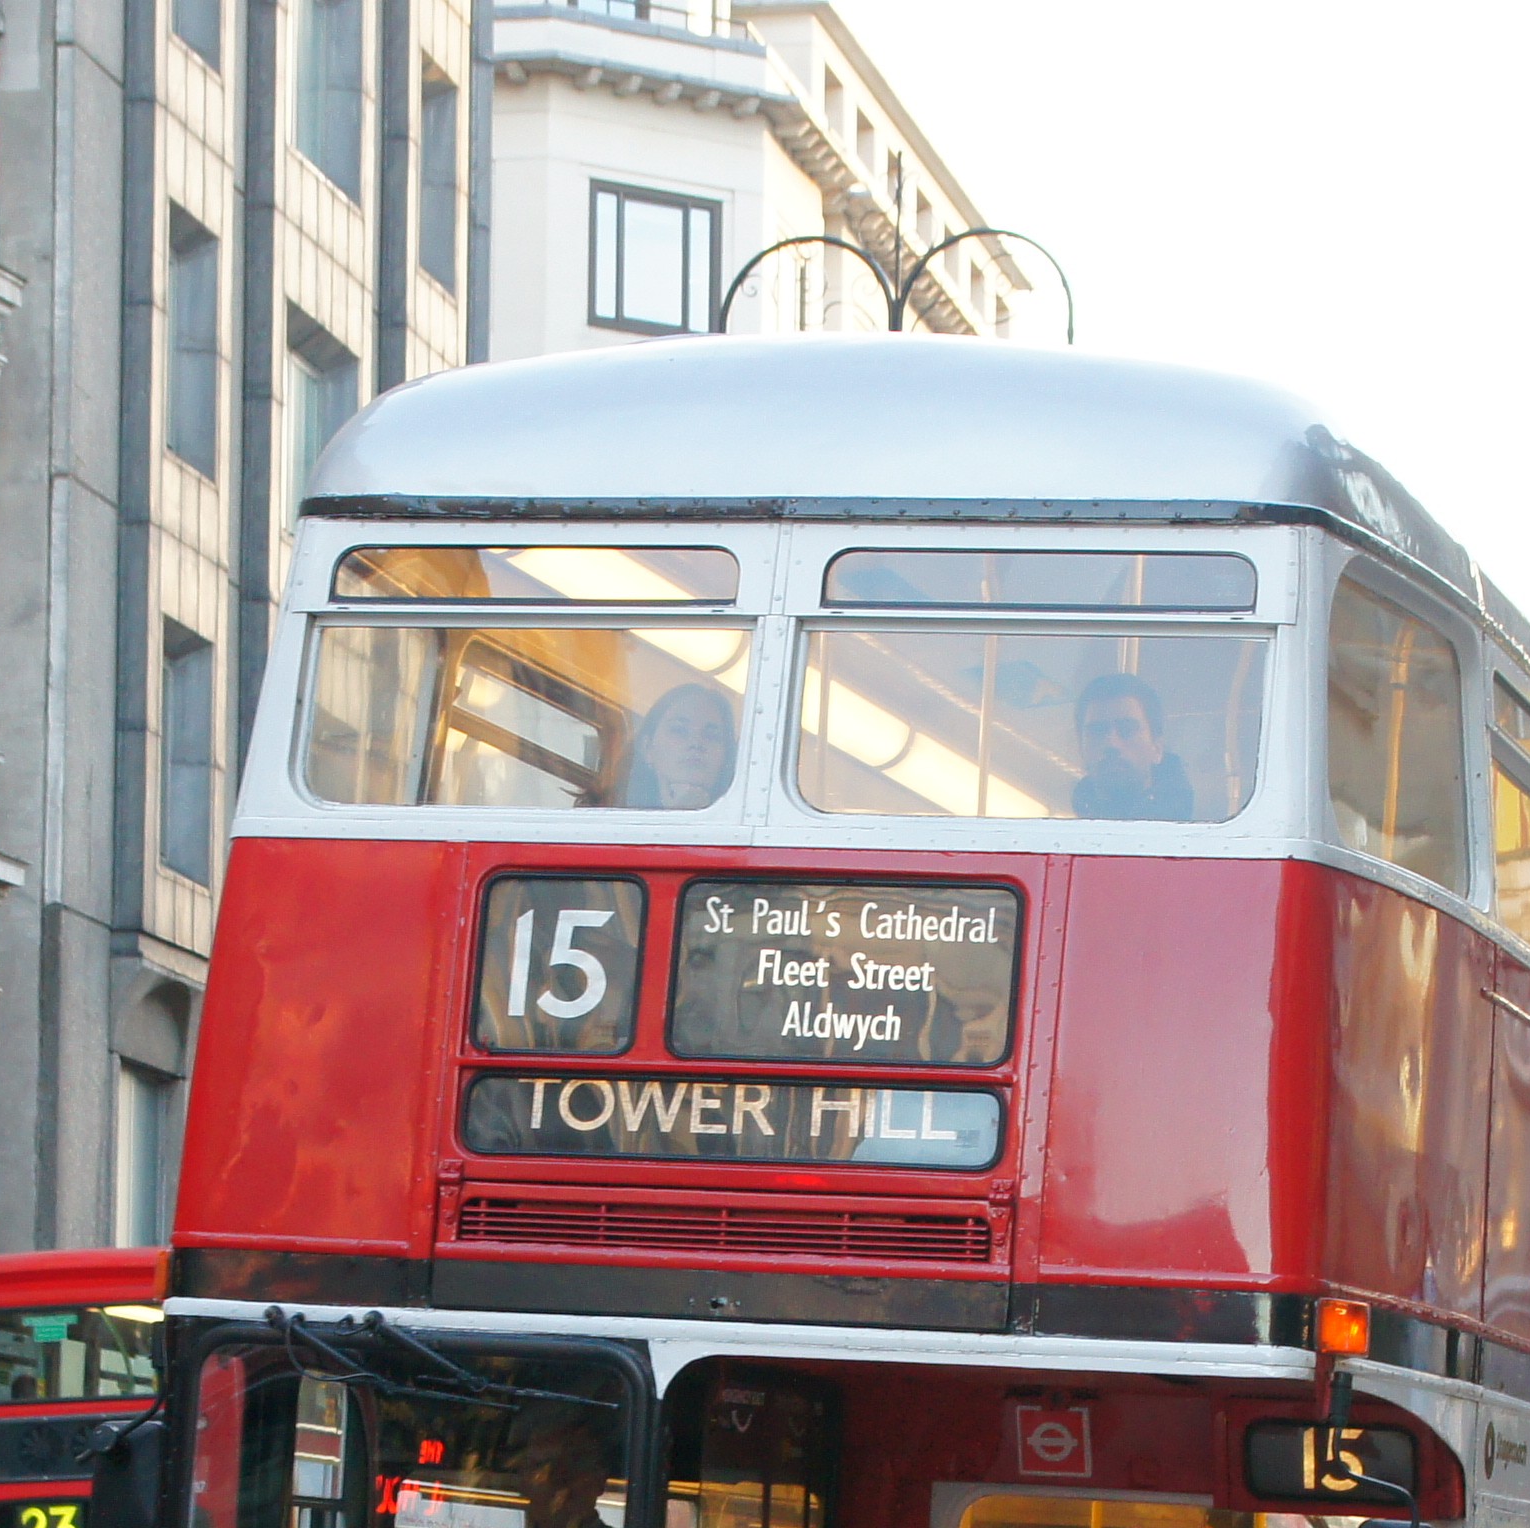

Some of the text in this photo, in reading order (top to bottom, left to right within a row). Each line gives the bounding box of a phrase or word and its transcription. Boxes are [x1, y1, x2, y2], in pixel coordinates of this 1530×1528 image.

[704, 896, 998, 945] St Paul's Cathedral
[507, 908, 615, 1019] 15
[757, 948, 935, 993] Fleet Street
[781, 1001, 901, 1051] Aldwych
[517, 1078, 958, 1141] TOWER HILL
[1303, 1426, 1364, 1492] 15
